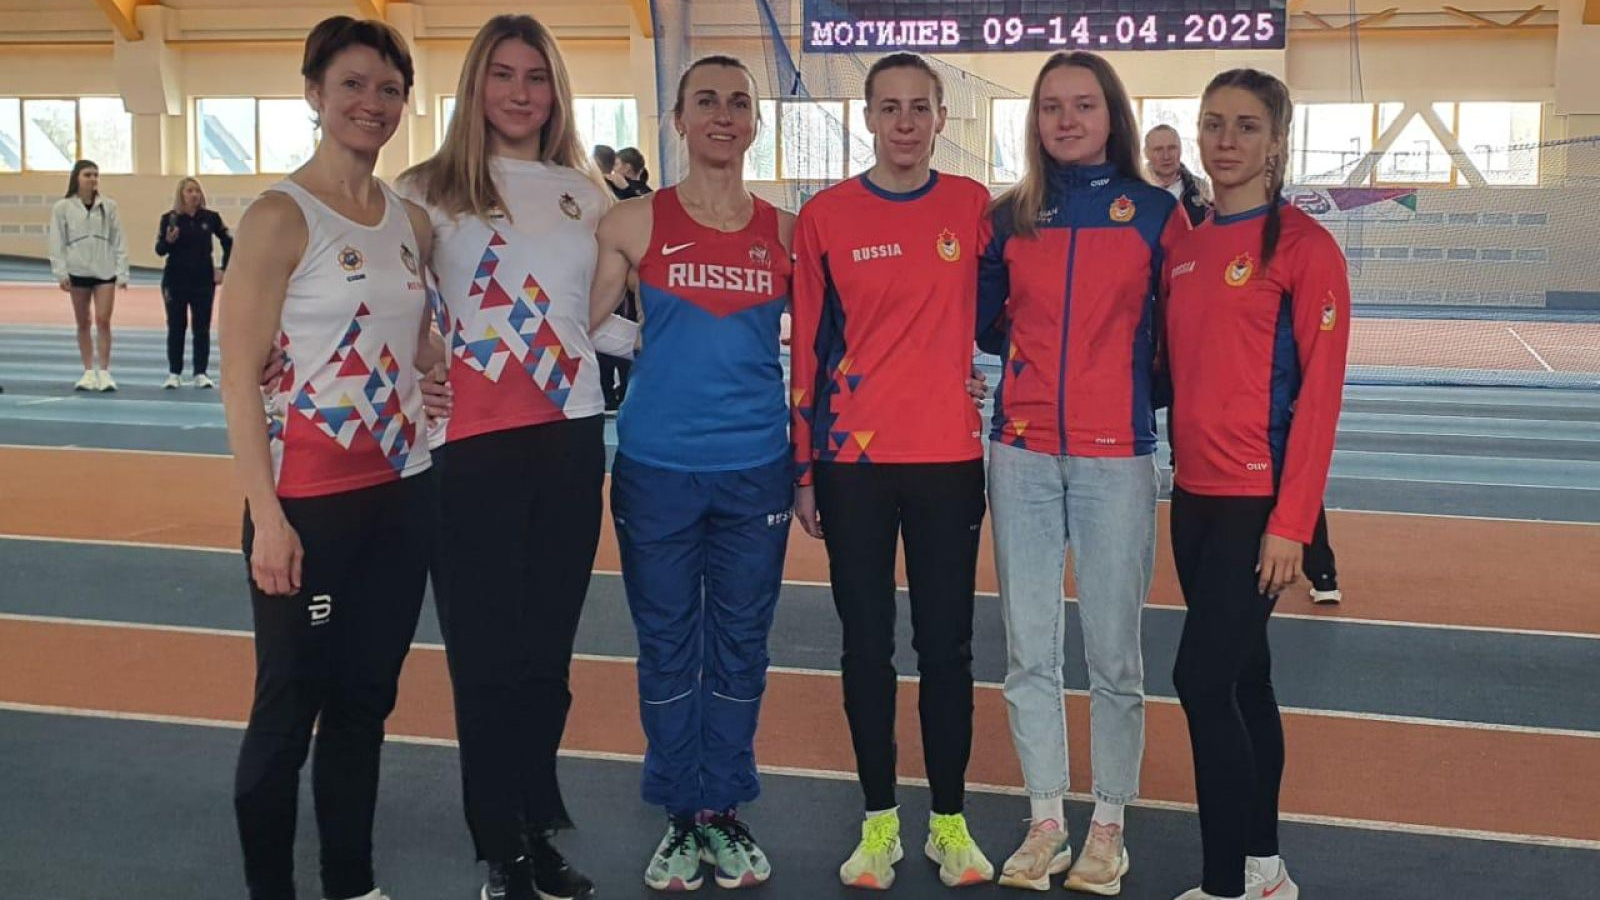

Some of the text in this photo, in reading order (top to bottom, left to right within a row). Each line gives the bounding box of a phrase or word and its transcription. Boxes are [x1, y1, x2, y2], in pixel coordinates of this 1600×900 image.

[811, 13, 1275, 46] МОГИЛЕВ 09-14.04.2025
[852, 243, 902, 262] RUSSIA
[668, 263, 772, 295] RUSSIA
